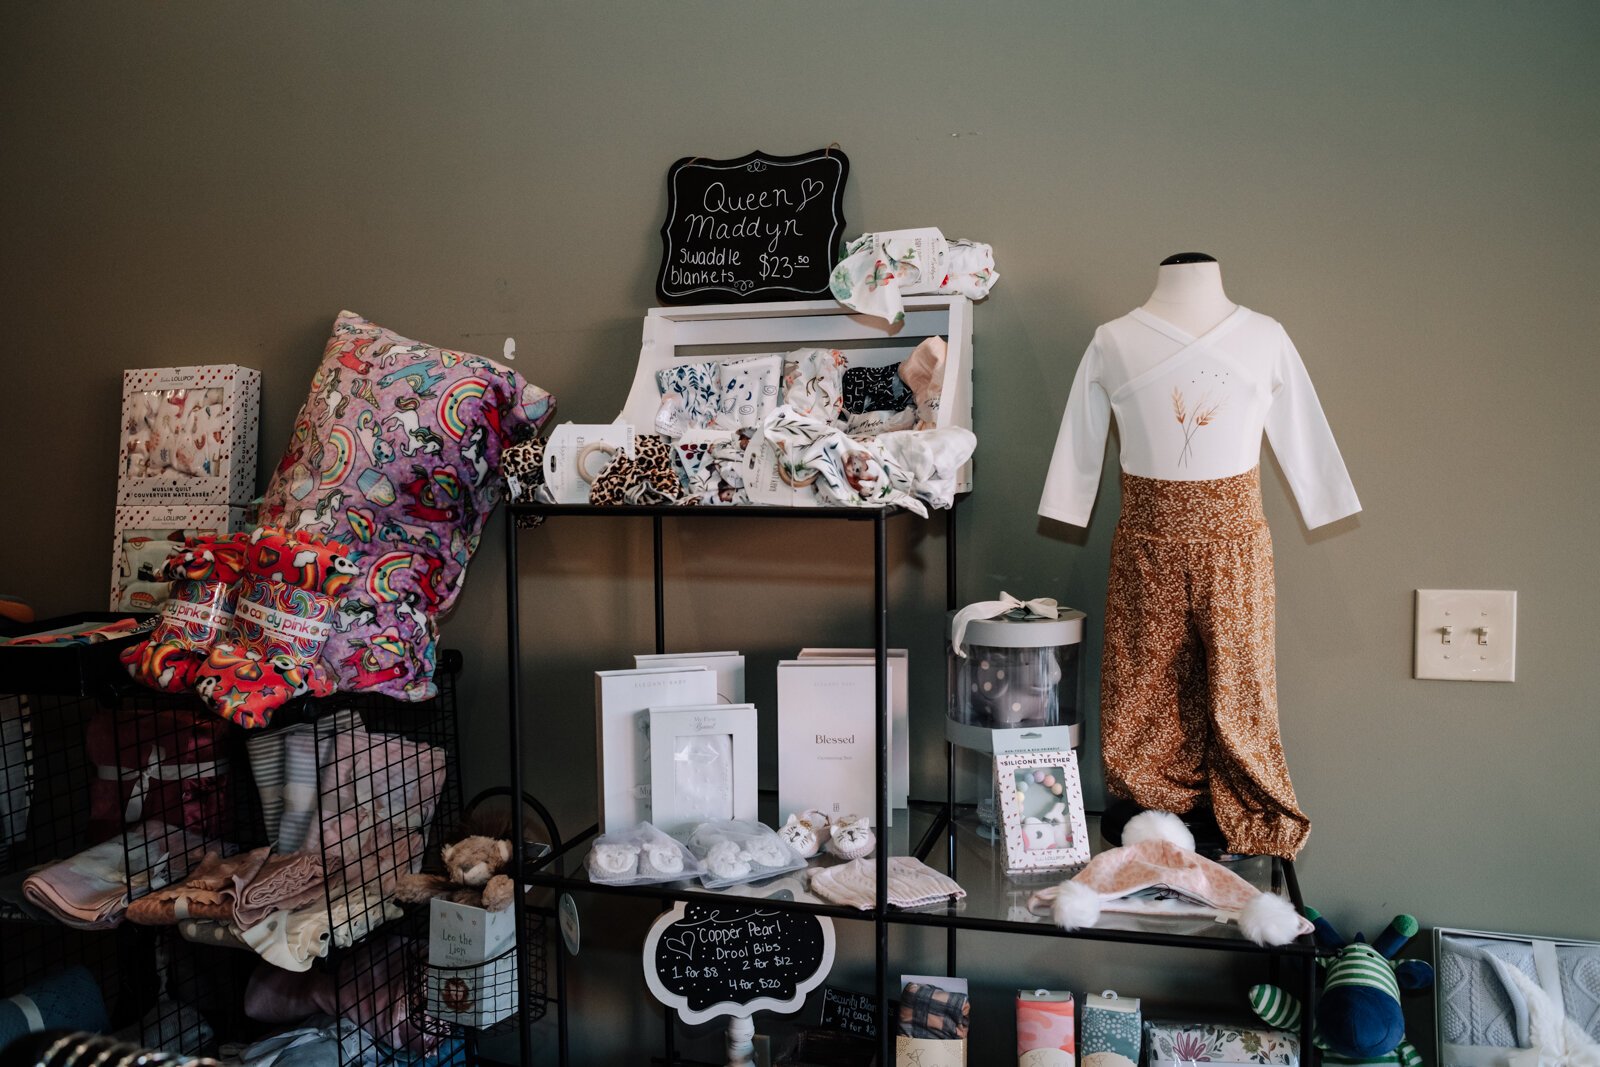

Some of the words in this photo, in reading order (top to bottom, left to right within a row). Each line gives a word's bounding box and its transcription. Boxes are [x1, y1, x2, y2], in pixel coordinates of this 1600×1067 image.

[703, 181, 793, 213] Queen
[684, 213, 803, 253] Maddyn
[671, 265, 735, 285] blankets
[177, 604, 201, 619] pink
[250, 606, 281, 628] candy
[281, 618, 309, 635] pink
[814, 734, 855, 744] Blessed
[1004, 758, 1037, 766] SILICONE
[442, 929, 456, 942] Leo
[459, 932, 473, 946] the
[699, 926, 742, 945] Copper
[449, 943, 466, 956] Lion
[716, 945, 749, 960] Drool
[753, 942, 781, 955] Bibs
[742, 960, 751, 970] 2
[753, 958, 769, 968] for
[773, 955, 793, 967] $12
[671, 965, 682, 979] 1
[685, 965, 701, 978] for
[703, 966, 719, 978] $8
[728, 979, 738, 990] 4
[738, 979, 754, 989] for
[759, 977, 781, 989] $20
[852, 1010, 873, 1024] each
[849, 1021, 863, 1033] for
